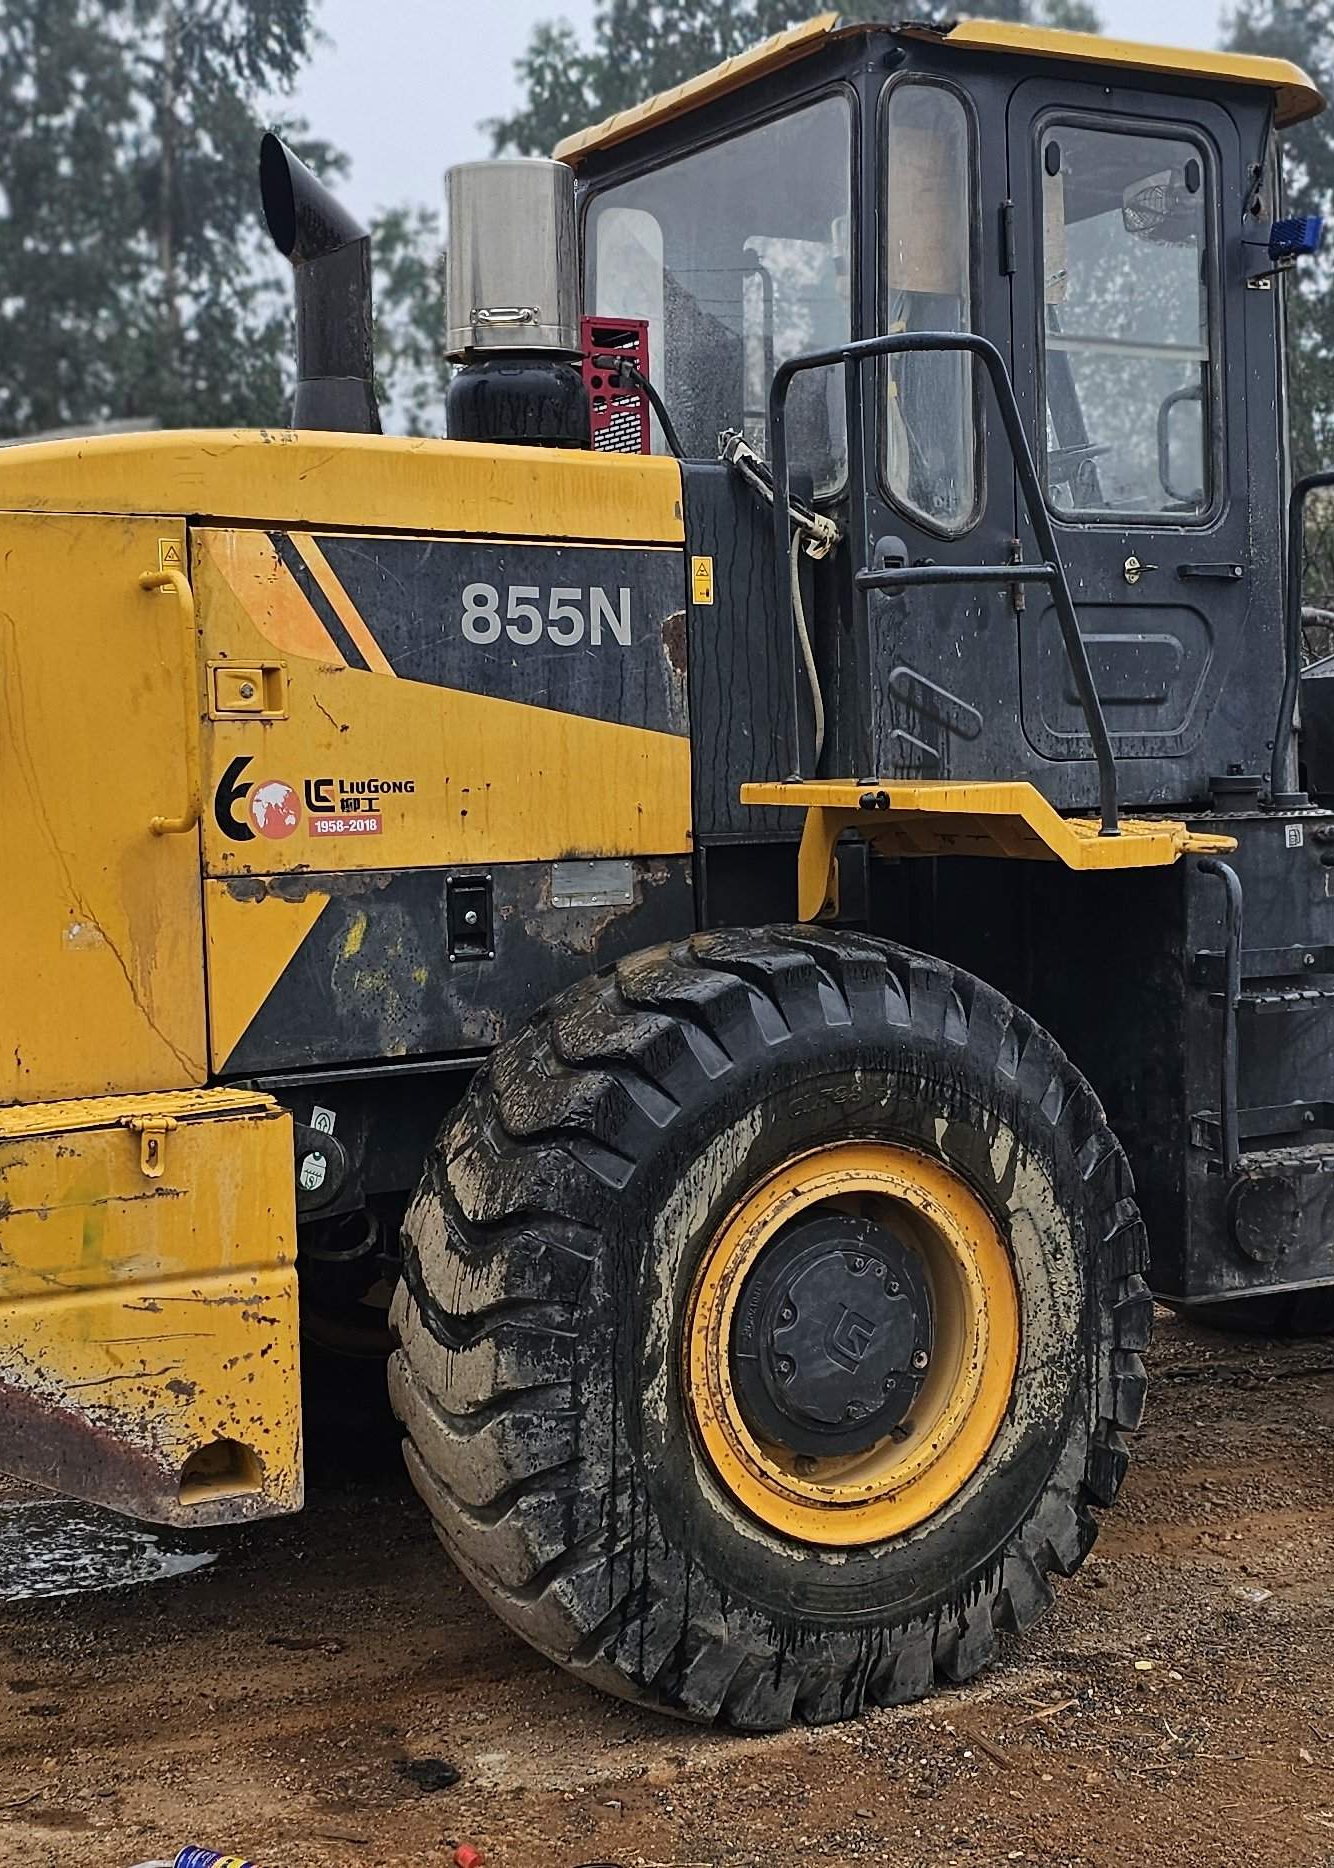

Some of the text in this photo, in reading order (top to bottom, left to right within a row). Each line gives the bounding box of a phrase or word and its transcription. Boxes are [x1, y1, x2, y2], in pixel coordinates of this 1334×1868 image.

[461, 582, 632, 647] 855N
[340, 797, 381, 813] 柳工
[314, 818, 378, 833] 1958-2018
